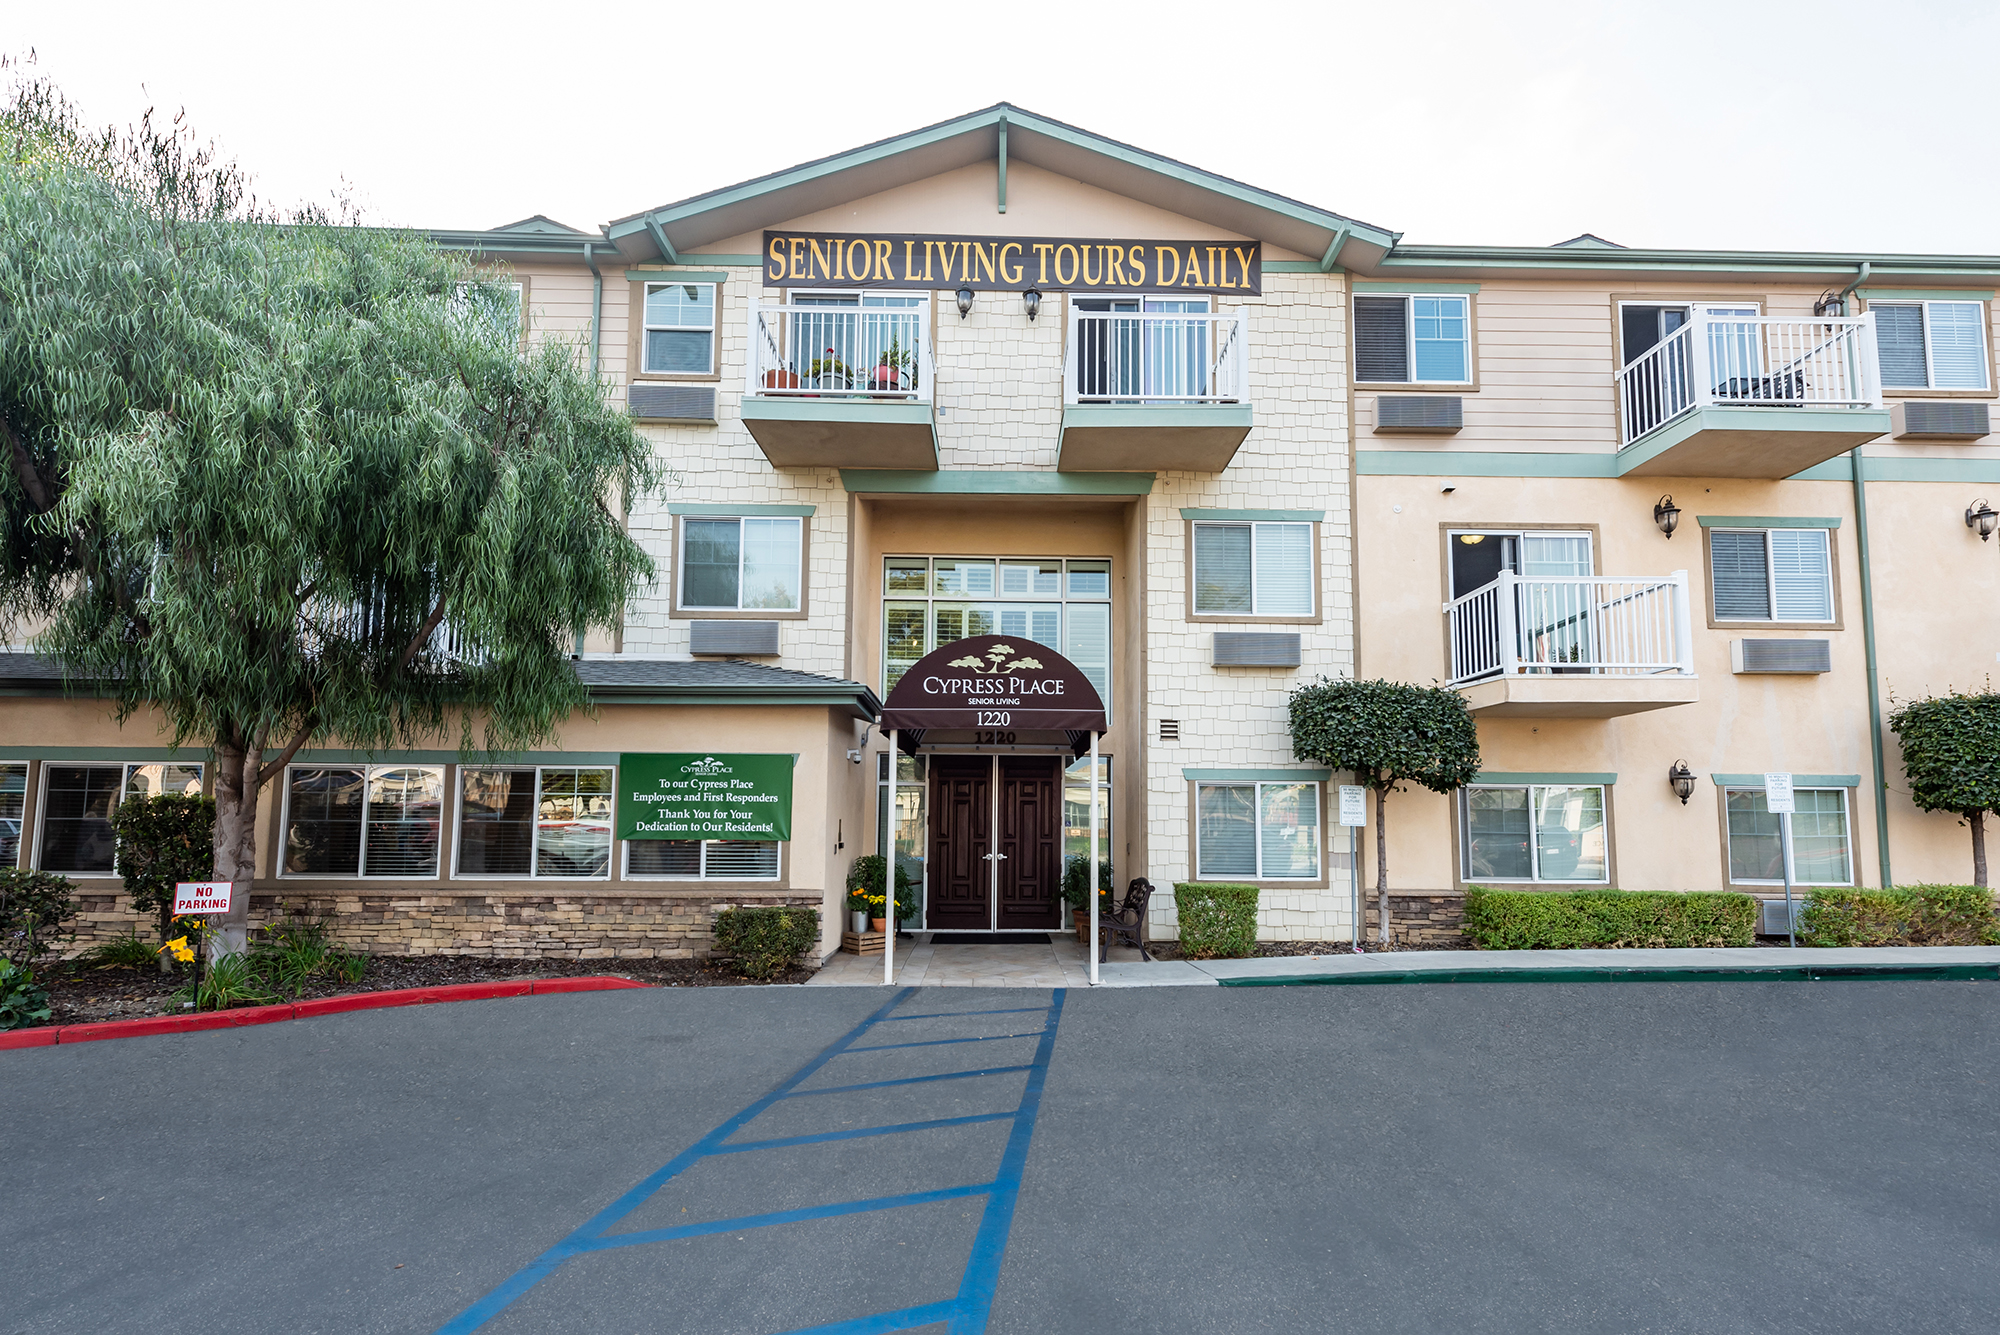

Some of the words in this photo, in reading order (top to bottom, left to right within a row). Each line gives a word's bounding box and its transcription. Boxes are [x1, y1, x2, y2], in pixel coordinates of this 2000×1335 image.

[769, 237, 895, 281] SENIOR
[904, 241, 1024, 284] LIVING
[1033, 243, 1146, 287] TOURS
[1154, 246, 1255, 289] DAILY
[923, 676, 1004, 694] CYPRESS
[1009, 677, 1065, 695] PLACE
[996, 698, 1020, 706] LIVING
[977, 711, 1011, 727] 1220
[975, 731, 1016, 745] 1220
[680, 765, 711, 773] CYPRESS
[659, 779, 671, 789] To
[672, 781, 689, 789] our
[690, 779, 729, 791] Cypress
[730, 779, 754, 789] Place
[633, 792, 682, 804] Employees
[683, 792, 701, 802] and
[703, 792, 724, 802] First
[725, 793, 779, 805] Responders
[658, 808, 690, 819] Thank
[692, 809, 711, 819] You
[713, 809, 728, 819] for
[730, 809, 753, 819] Your
[636, 821, 688, 831] Dedication
[690, 822, 700, 832] to
[702, 821, 723, 832] Our
[724, 822, 774, 832] Residents!
[195, 887, 213, 897] NO
[178, 899, 227, 909] PARKING
